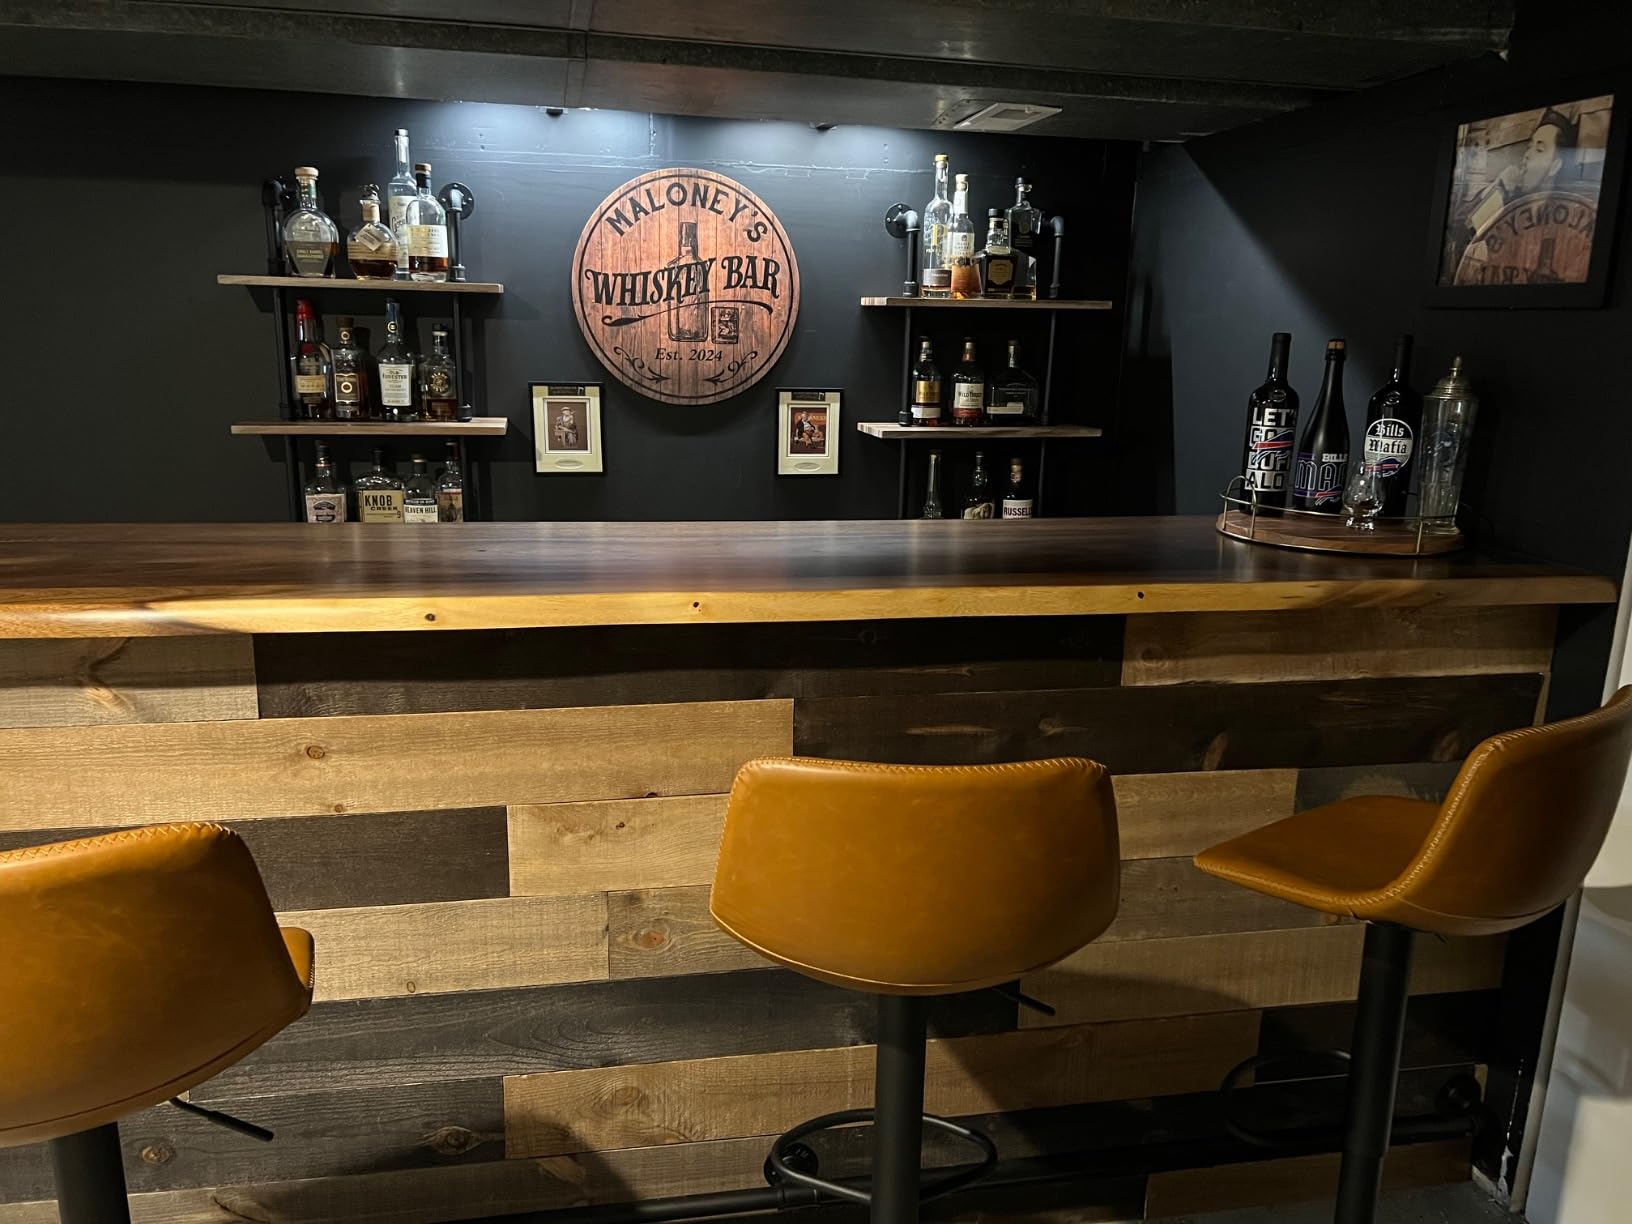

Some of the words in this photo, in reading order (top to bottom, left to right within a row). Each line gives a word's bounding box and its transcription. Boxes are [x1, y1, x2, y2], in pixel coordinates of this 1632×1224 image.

[604, 182, 768, 243] MALONEY'S
[584, 257, 716, 306] WHISKEY
[721, 255, 780, 299] BAR
[654, 347, 683, 361] Est.
[688, 348, 723, 362] 2024
[1375, 423, 1405, 438] Bills
[1368, 439, 1407, 455] Mafia
[1245, 471, 1285, 490] ALO
[365, 495, 393, 507] KNOB
[397, 511, 402, 519] 9
[424, 506, 437, 514] HILL
